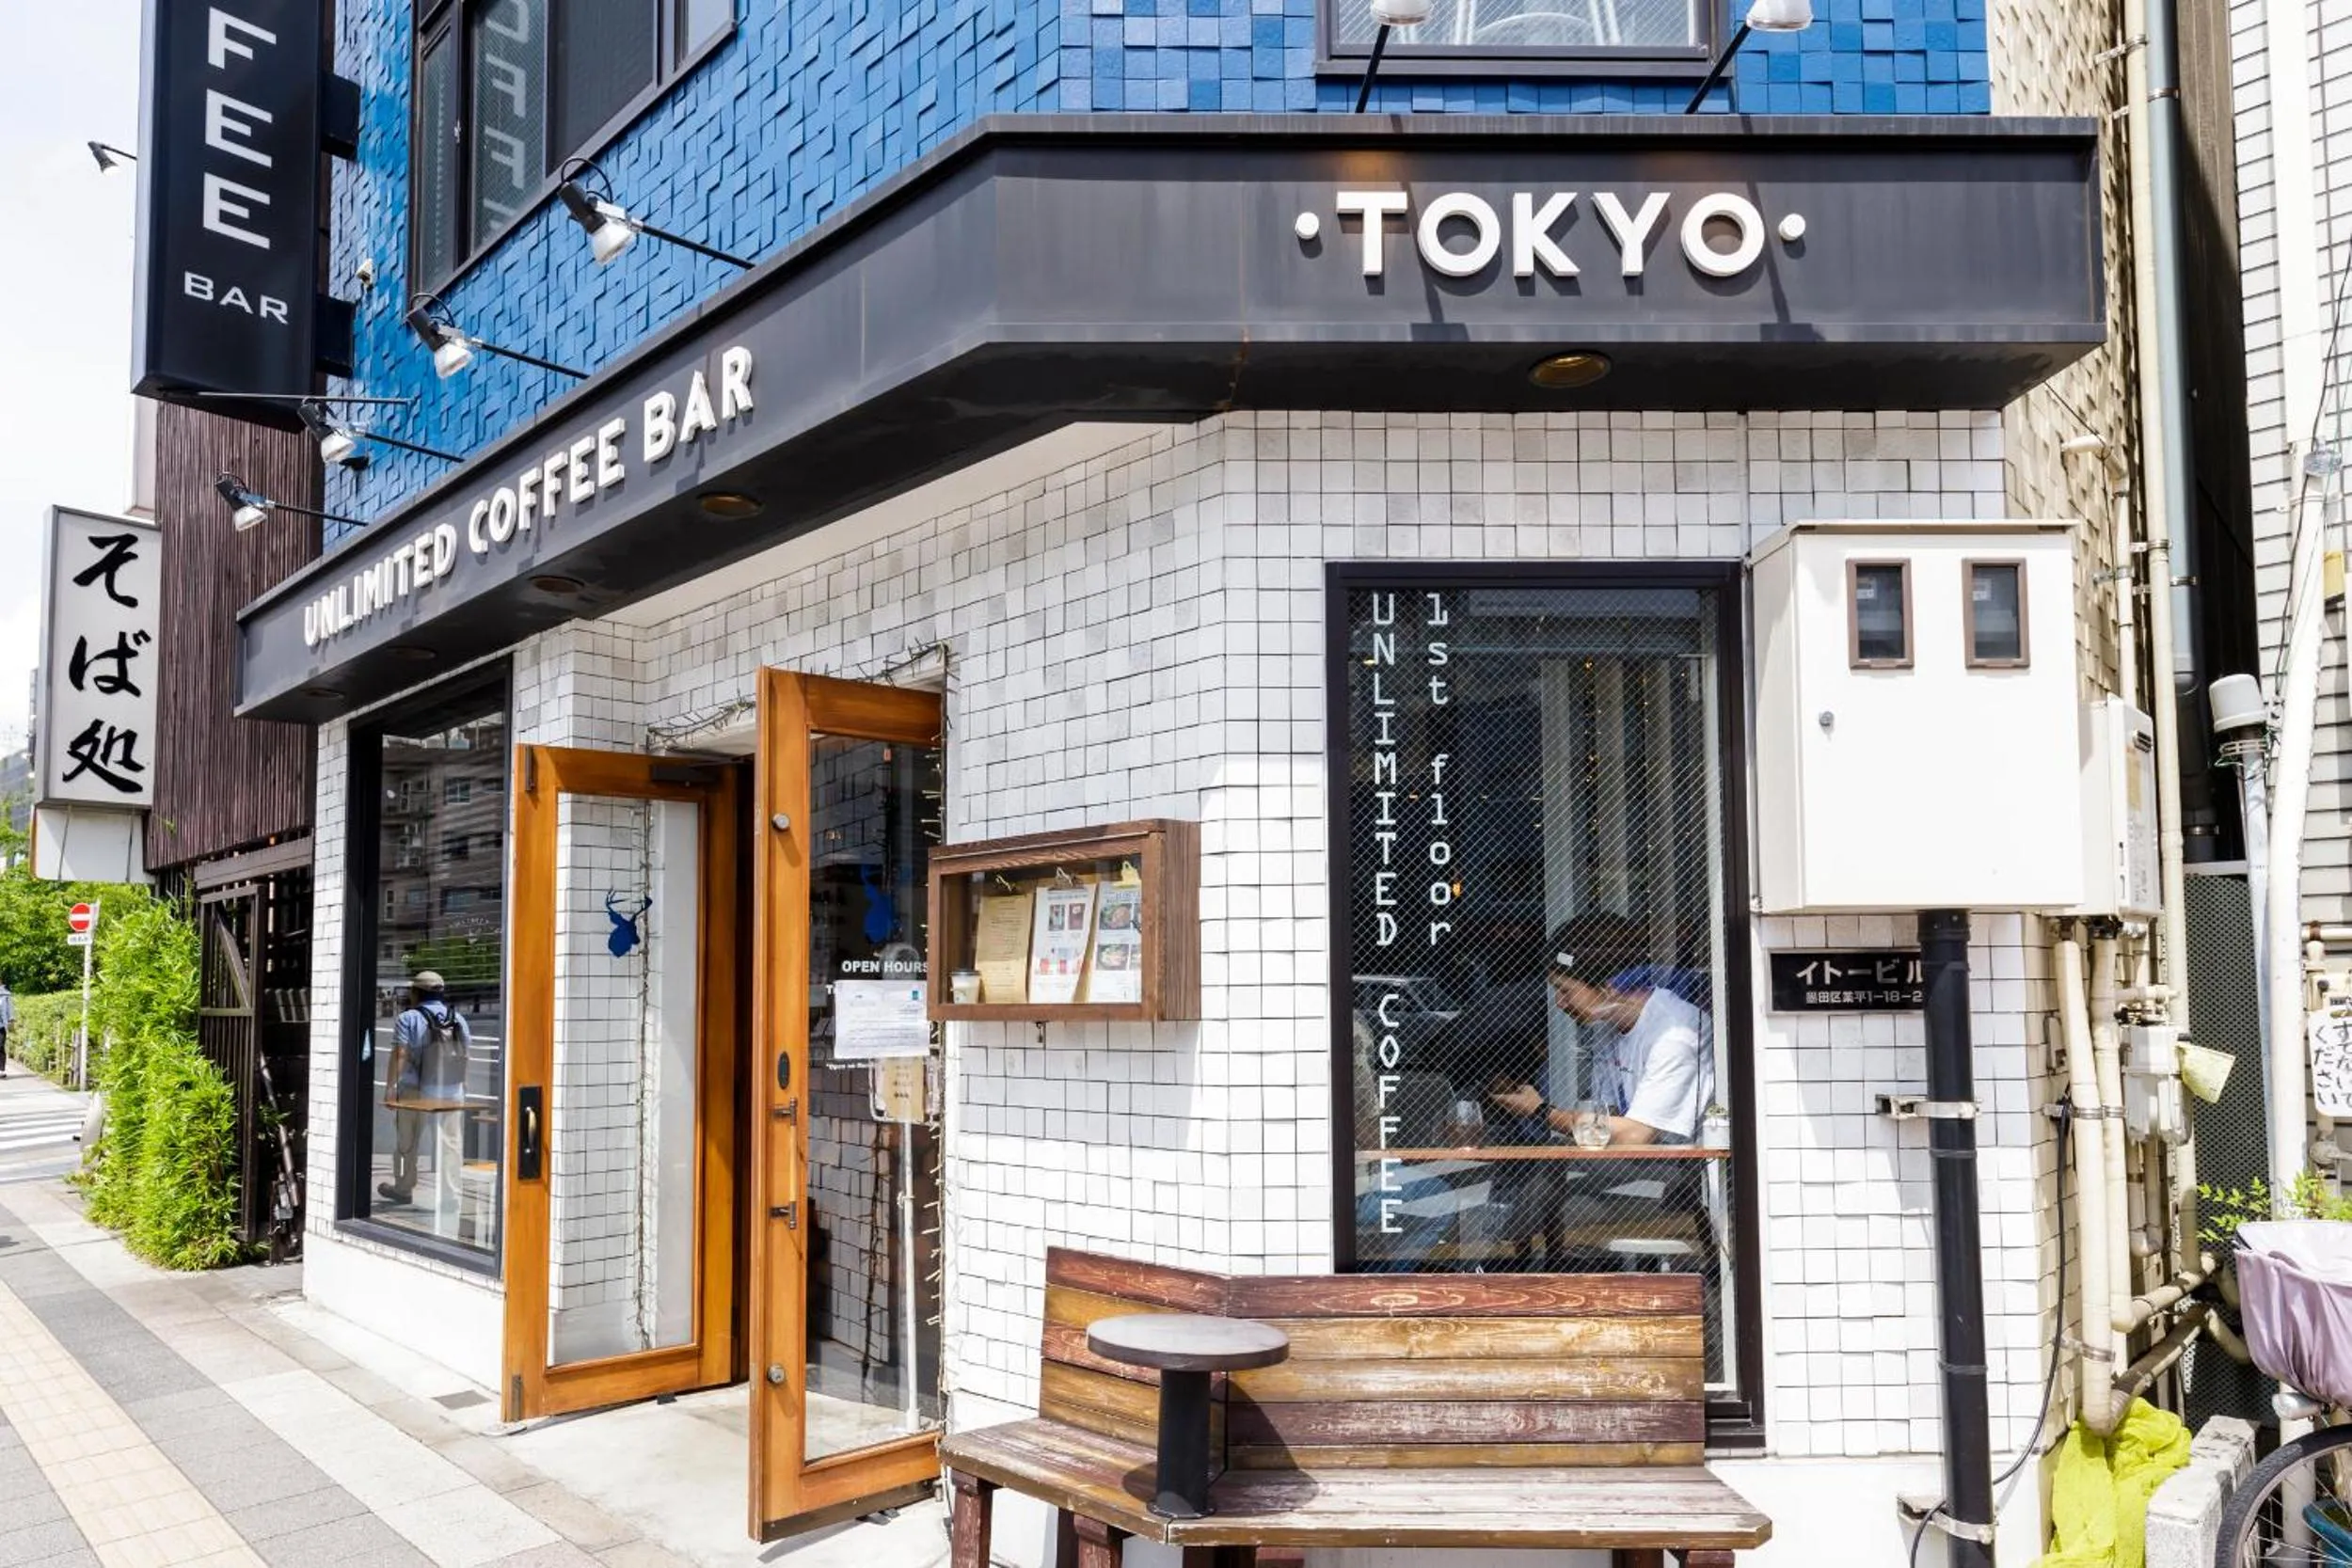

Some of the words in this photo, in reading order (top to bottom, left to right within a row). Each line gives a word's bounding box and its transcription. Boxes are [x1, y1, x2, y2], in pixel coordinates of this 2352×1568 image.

[184, 271, 289, 325] BAR
[303, 523, 458, 646] UNLIMITED
[469, 417, 626, 553] COFFEE
[644, 345, 754, 463] BAR
[62, 533, 152, 793] そば処
[1426, 594, 1449, 705] 1st
[1373, 594, 1398, 946] UNLIMITED
[1429, 753, 1452, 946] floor
[842, 960, 881, 973] OPEN
[884, 960, 929, 973] HOURS
[1796, 958, 1924, 986] イトービル
[1378, 993, 1403, 1233] COFFEE
[2314, 1025, 2338, 1105] ください
